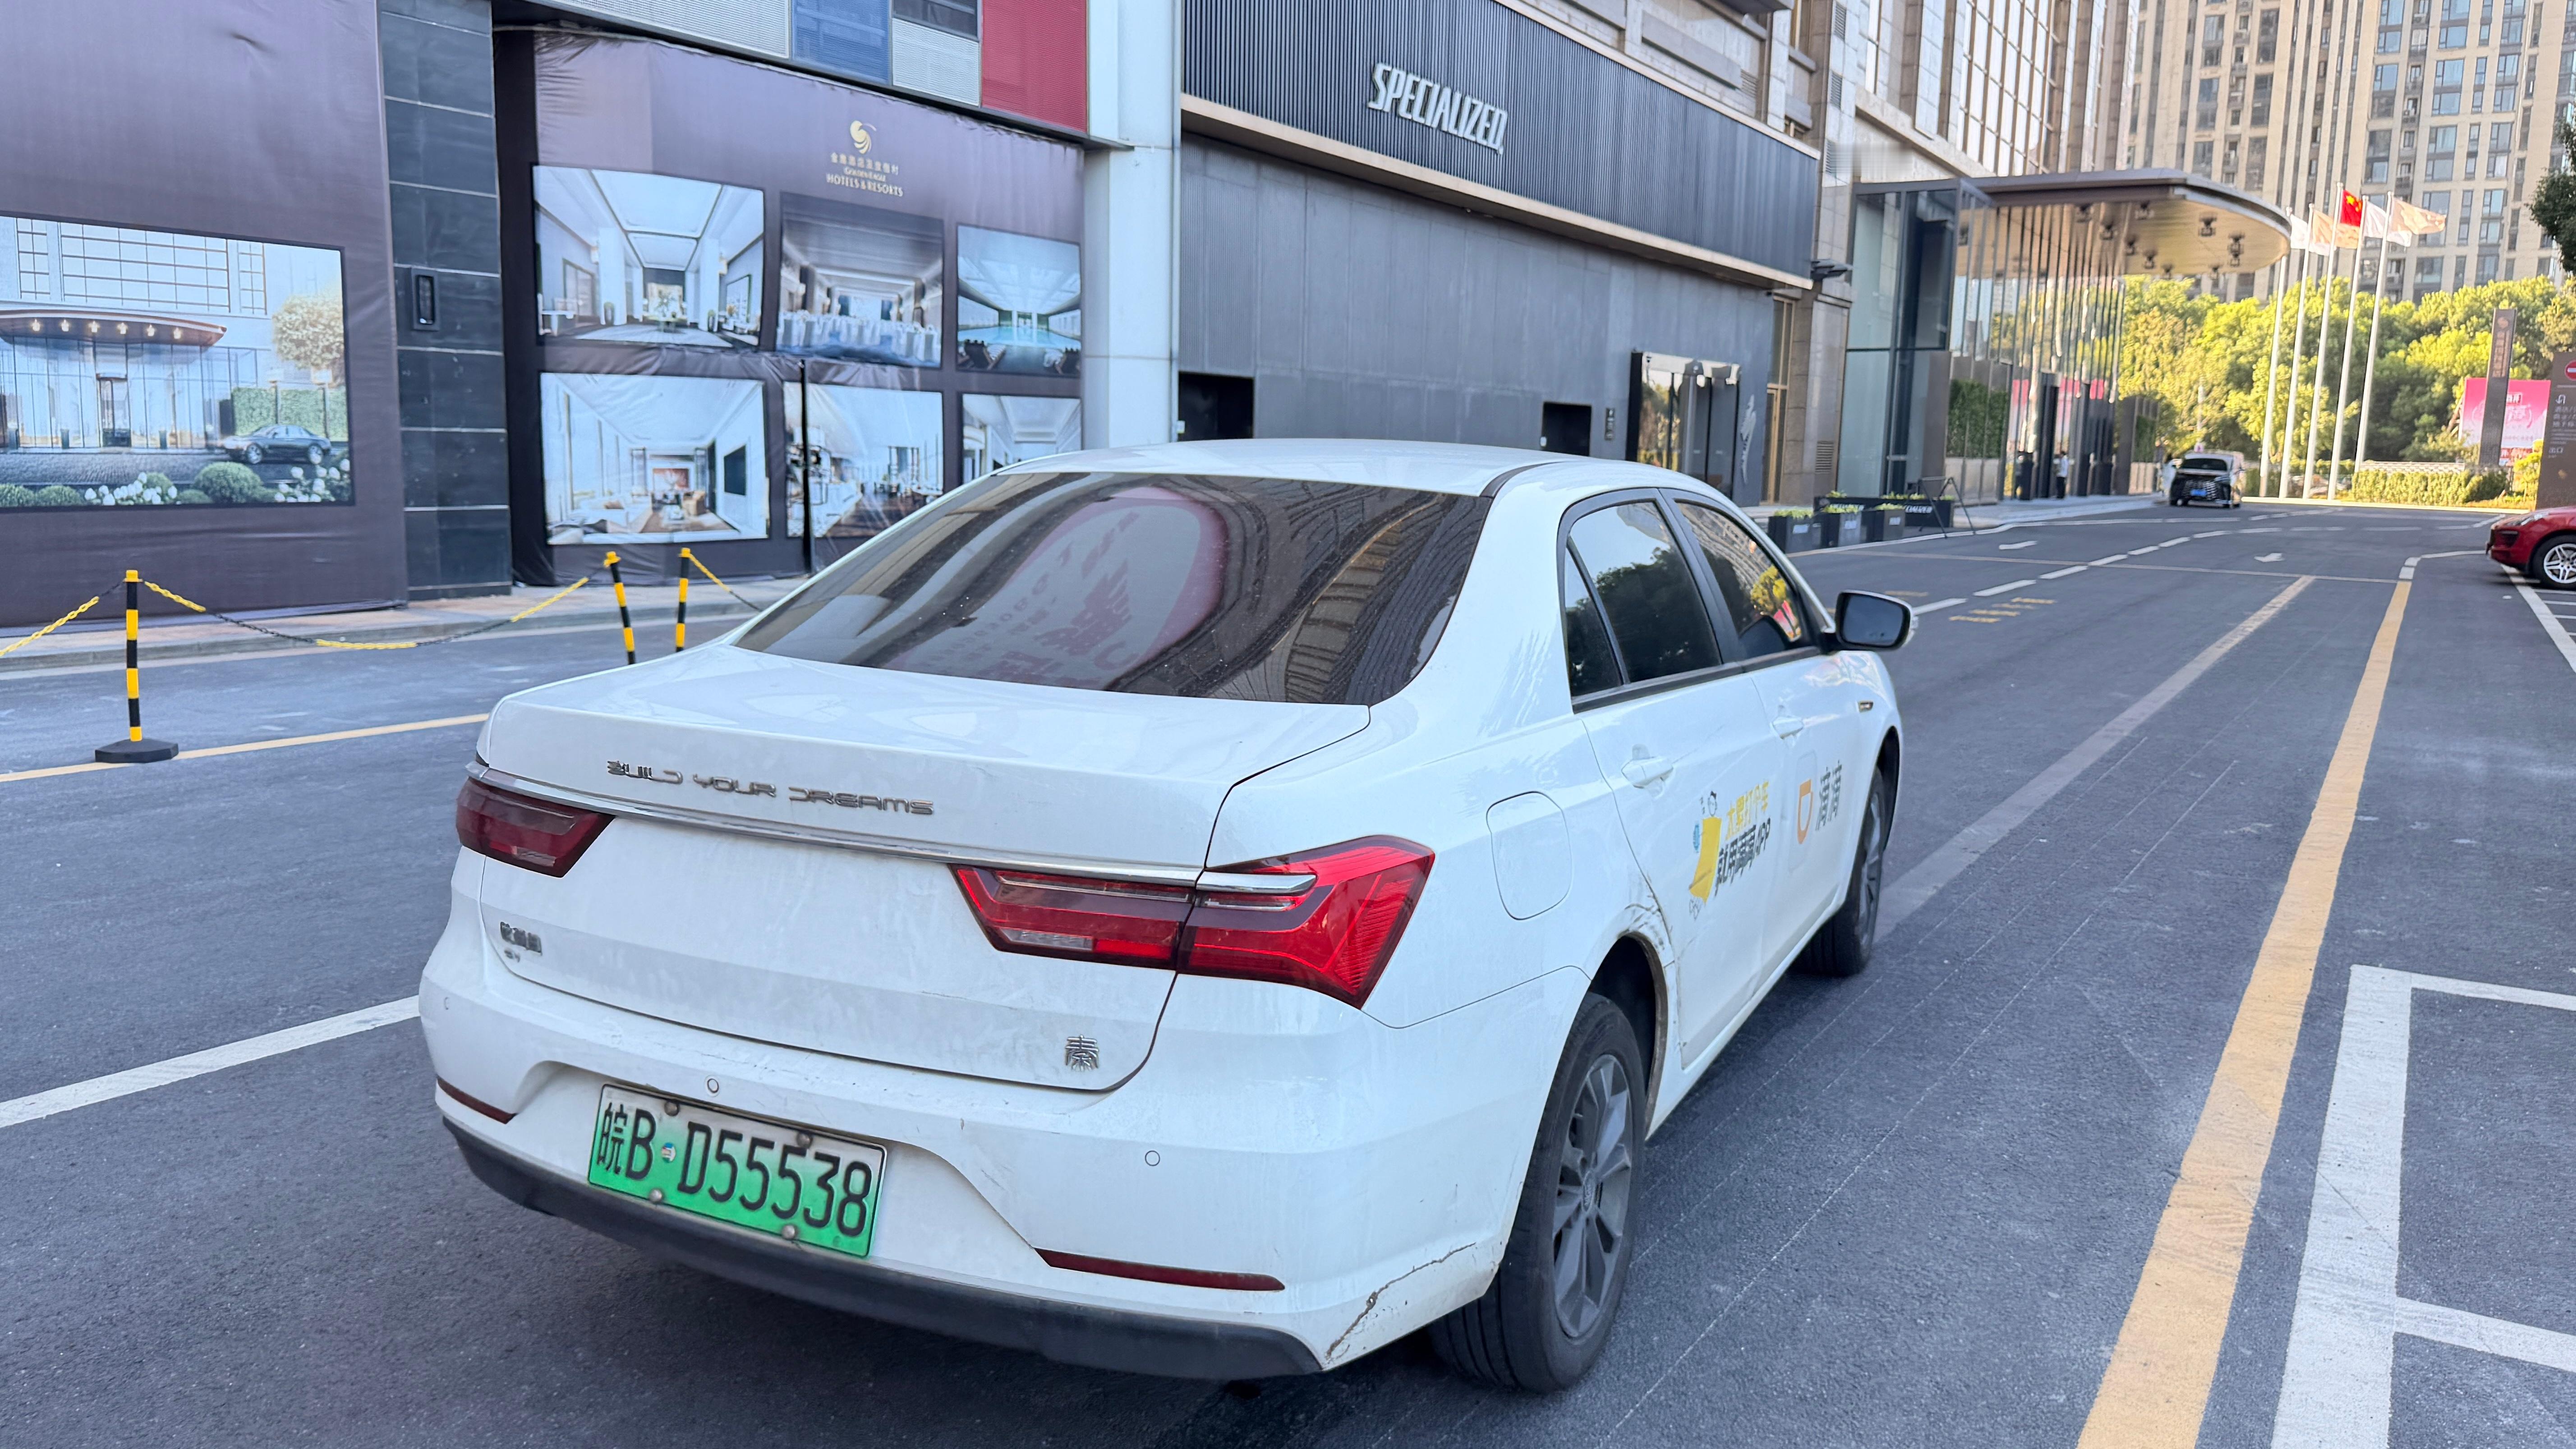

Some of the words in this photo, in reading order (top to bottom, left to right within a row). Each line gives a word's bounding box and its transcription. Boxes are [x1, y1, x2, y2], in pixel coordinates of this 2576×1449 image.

[1367, 62, 1508, 156] SPECIALIZED
[826, 173, 860, 189] HOTELS
[607, 759, 683, 785] BUILD
[693, 773, 777, 798] YOUR
[788, 786, 934, 815] DREAMS
[1065, 1034, 1099, 1072] 秦
[677, 1121, 872, 1237] D55538
